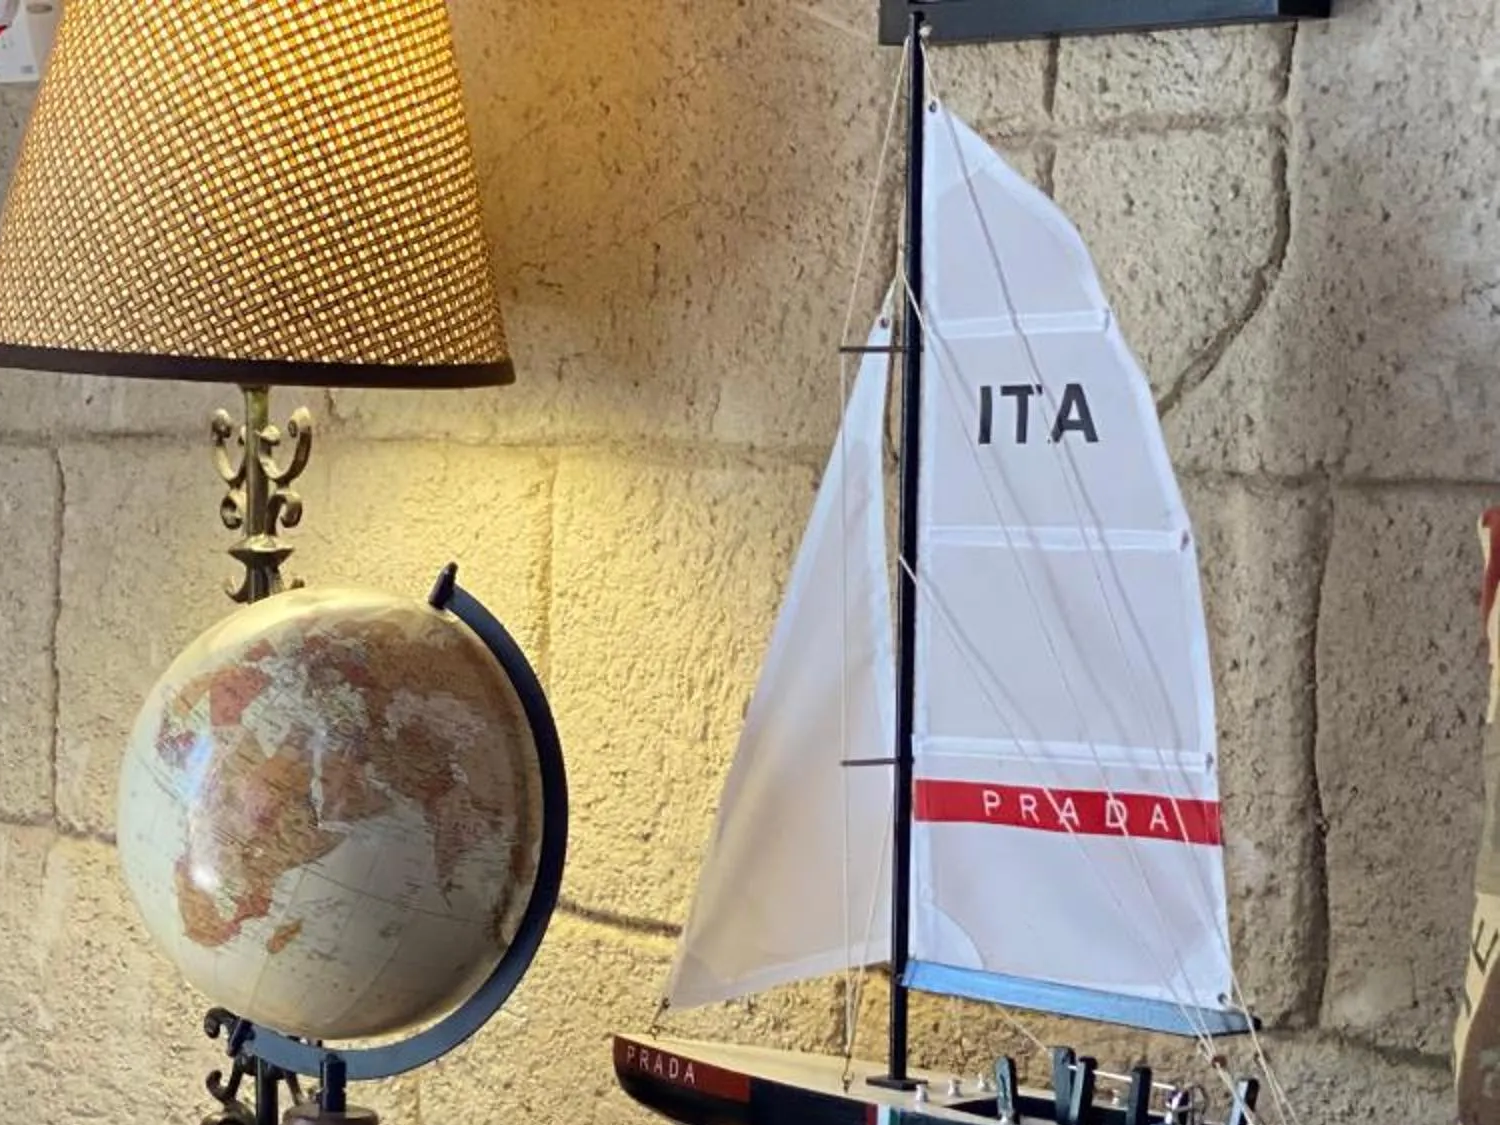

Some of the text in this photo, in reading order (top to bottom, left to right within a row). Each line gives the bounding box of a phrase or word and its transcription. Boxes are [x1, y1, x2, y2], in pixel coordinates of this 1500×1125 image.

[979, 383, 1099, 444] ITA
[982, 789, 1169, 832] PRADA
[626, 1045, 696, 1084] PRADA
